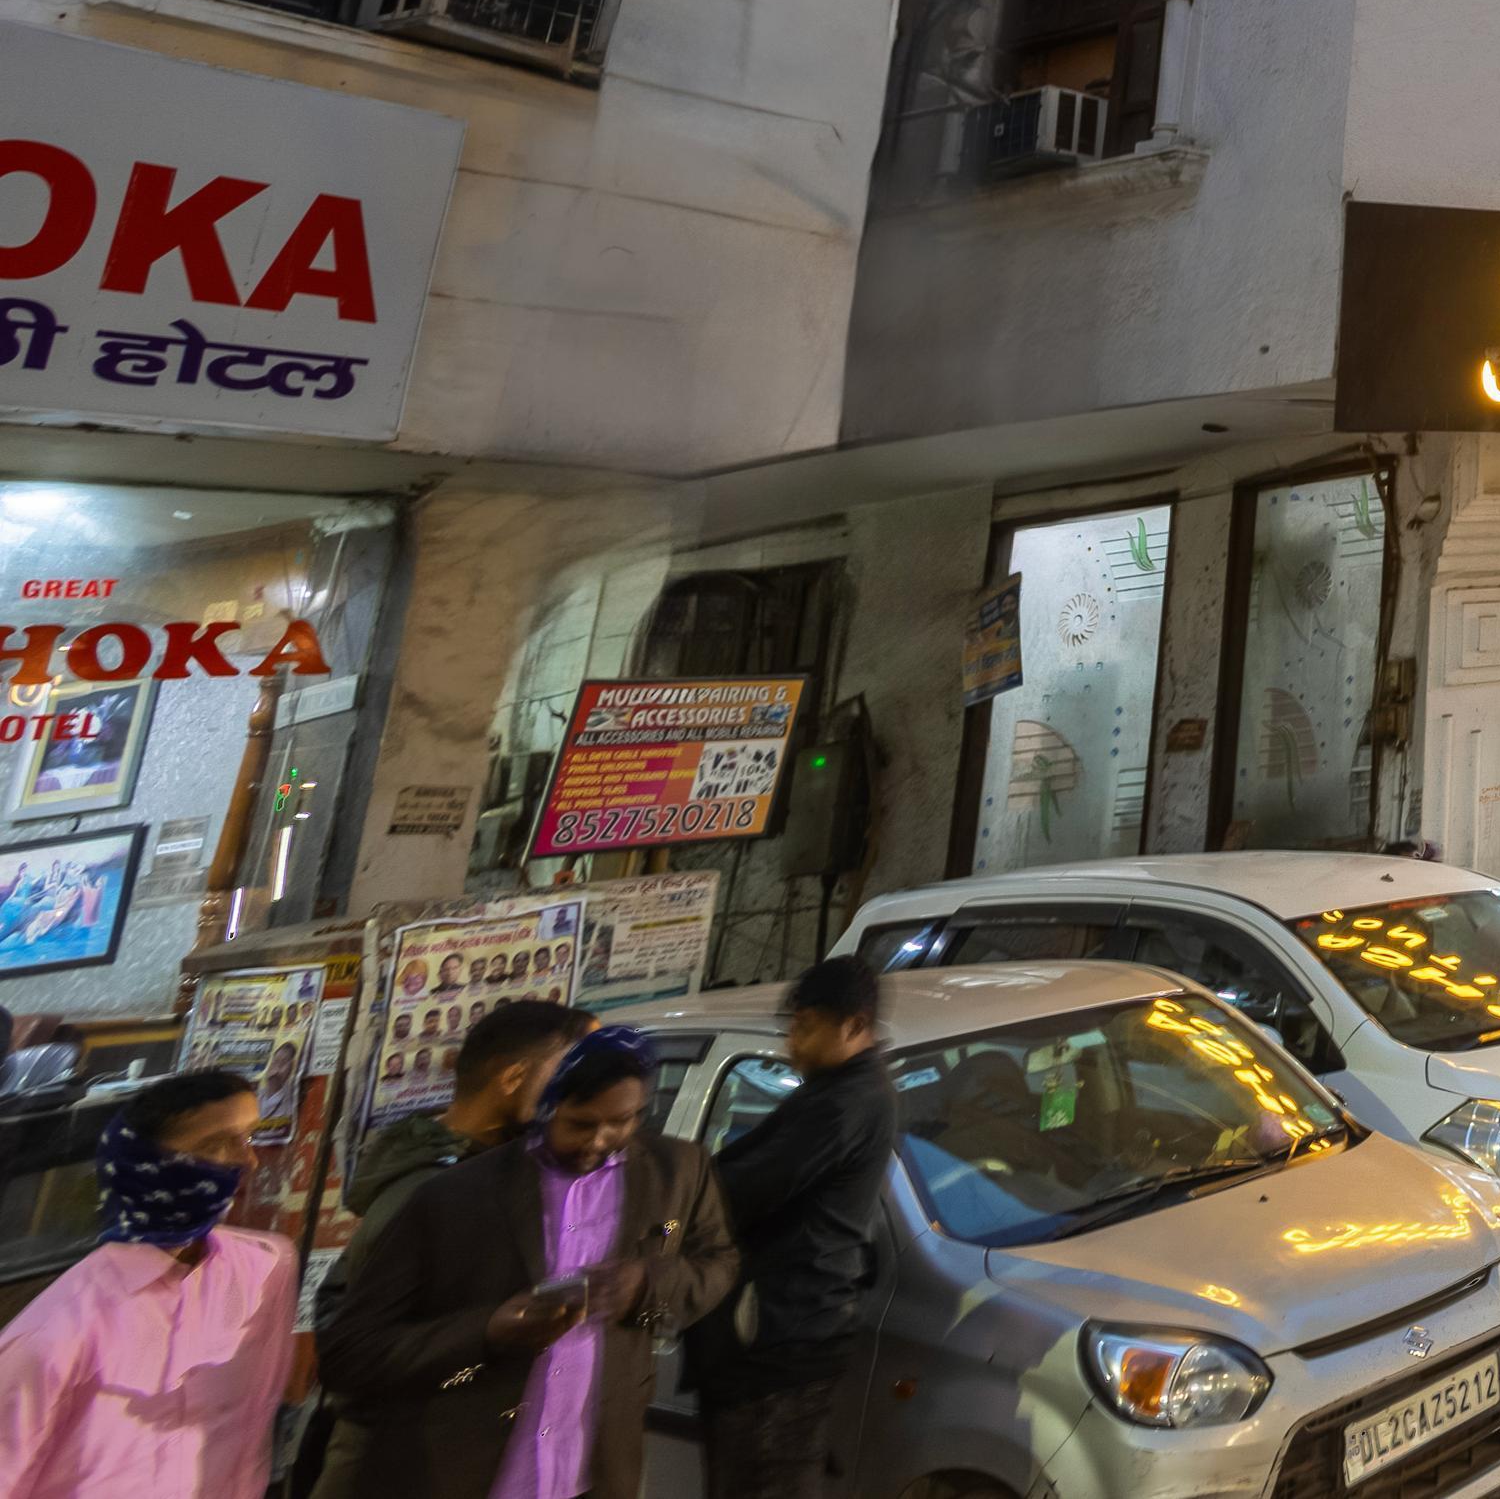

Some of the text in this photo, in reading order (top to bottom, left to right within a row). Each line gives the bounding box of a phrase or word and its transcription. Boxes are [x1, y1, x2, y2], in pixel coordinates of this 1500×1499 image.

[0, 139, 378, 324] OKA
[93, 320, 369, 400] होटल
[21, 579, 120, 599] GREAT
[0, 712, 98, 743] OTEL
[631, 706, 748, 729] ACCESSORIES
[552, 800, 757, 847] 8527520218
[1359, 1364, 1498, 1467] DL2CAZ5212
